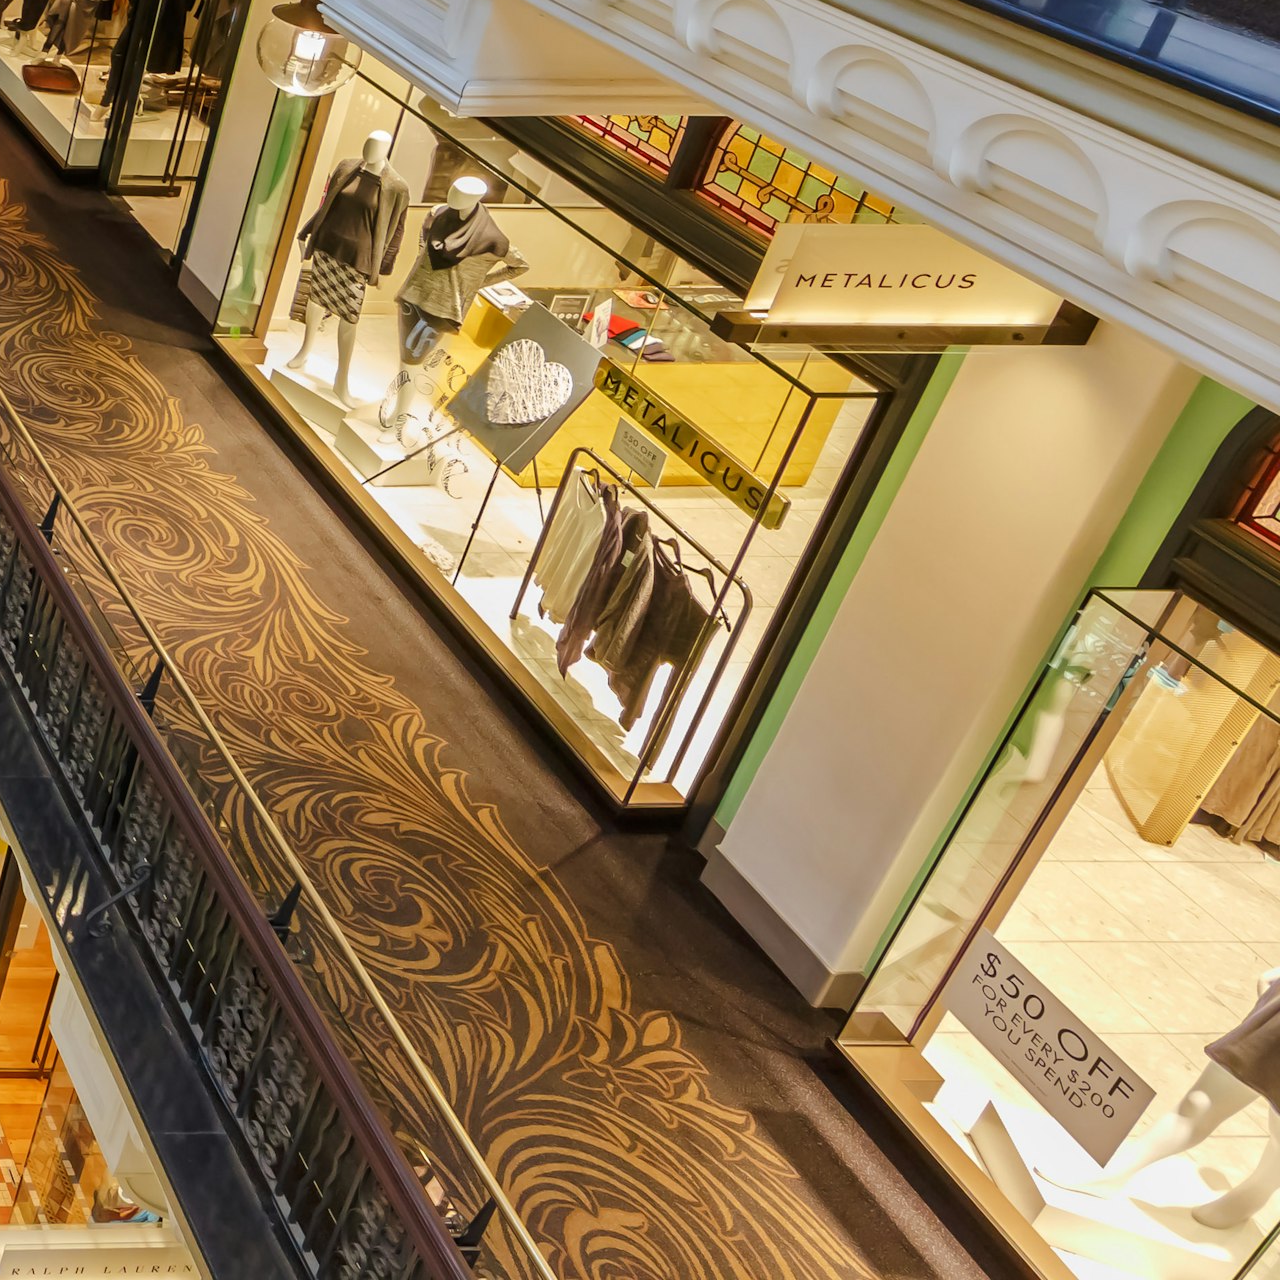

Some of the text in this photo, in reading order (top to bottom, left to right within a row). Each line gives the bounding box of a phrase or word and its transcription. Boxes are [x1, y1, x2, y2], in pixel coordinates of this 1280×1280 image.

[795, 273, 978, 290] METALICUS
[603, 370, 764, 512] METALICUS
[640, 445, 657, 461] OFF
[980, 952, 1045, 1021] $50
[1057, 1028, 1135, 1100] OFF
[984, 1003, 1022, 1046] YOU
[972, 974, 1008, 1013] FOR
[1010, 1013, 1064, 1065] EVERY
[1067, 1069, 1115, 1119] $200
[11, 1264, 193, 1276] RALPH LAUREN
